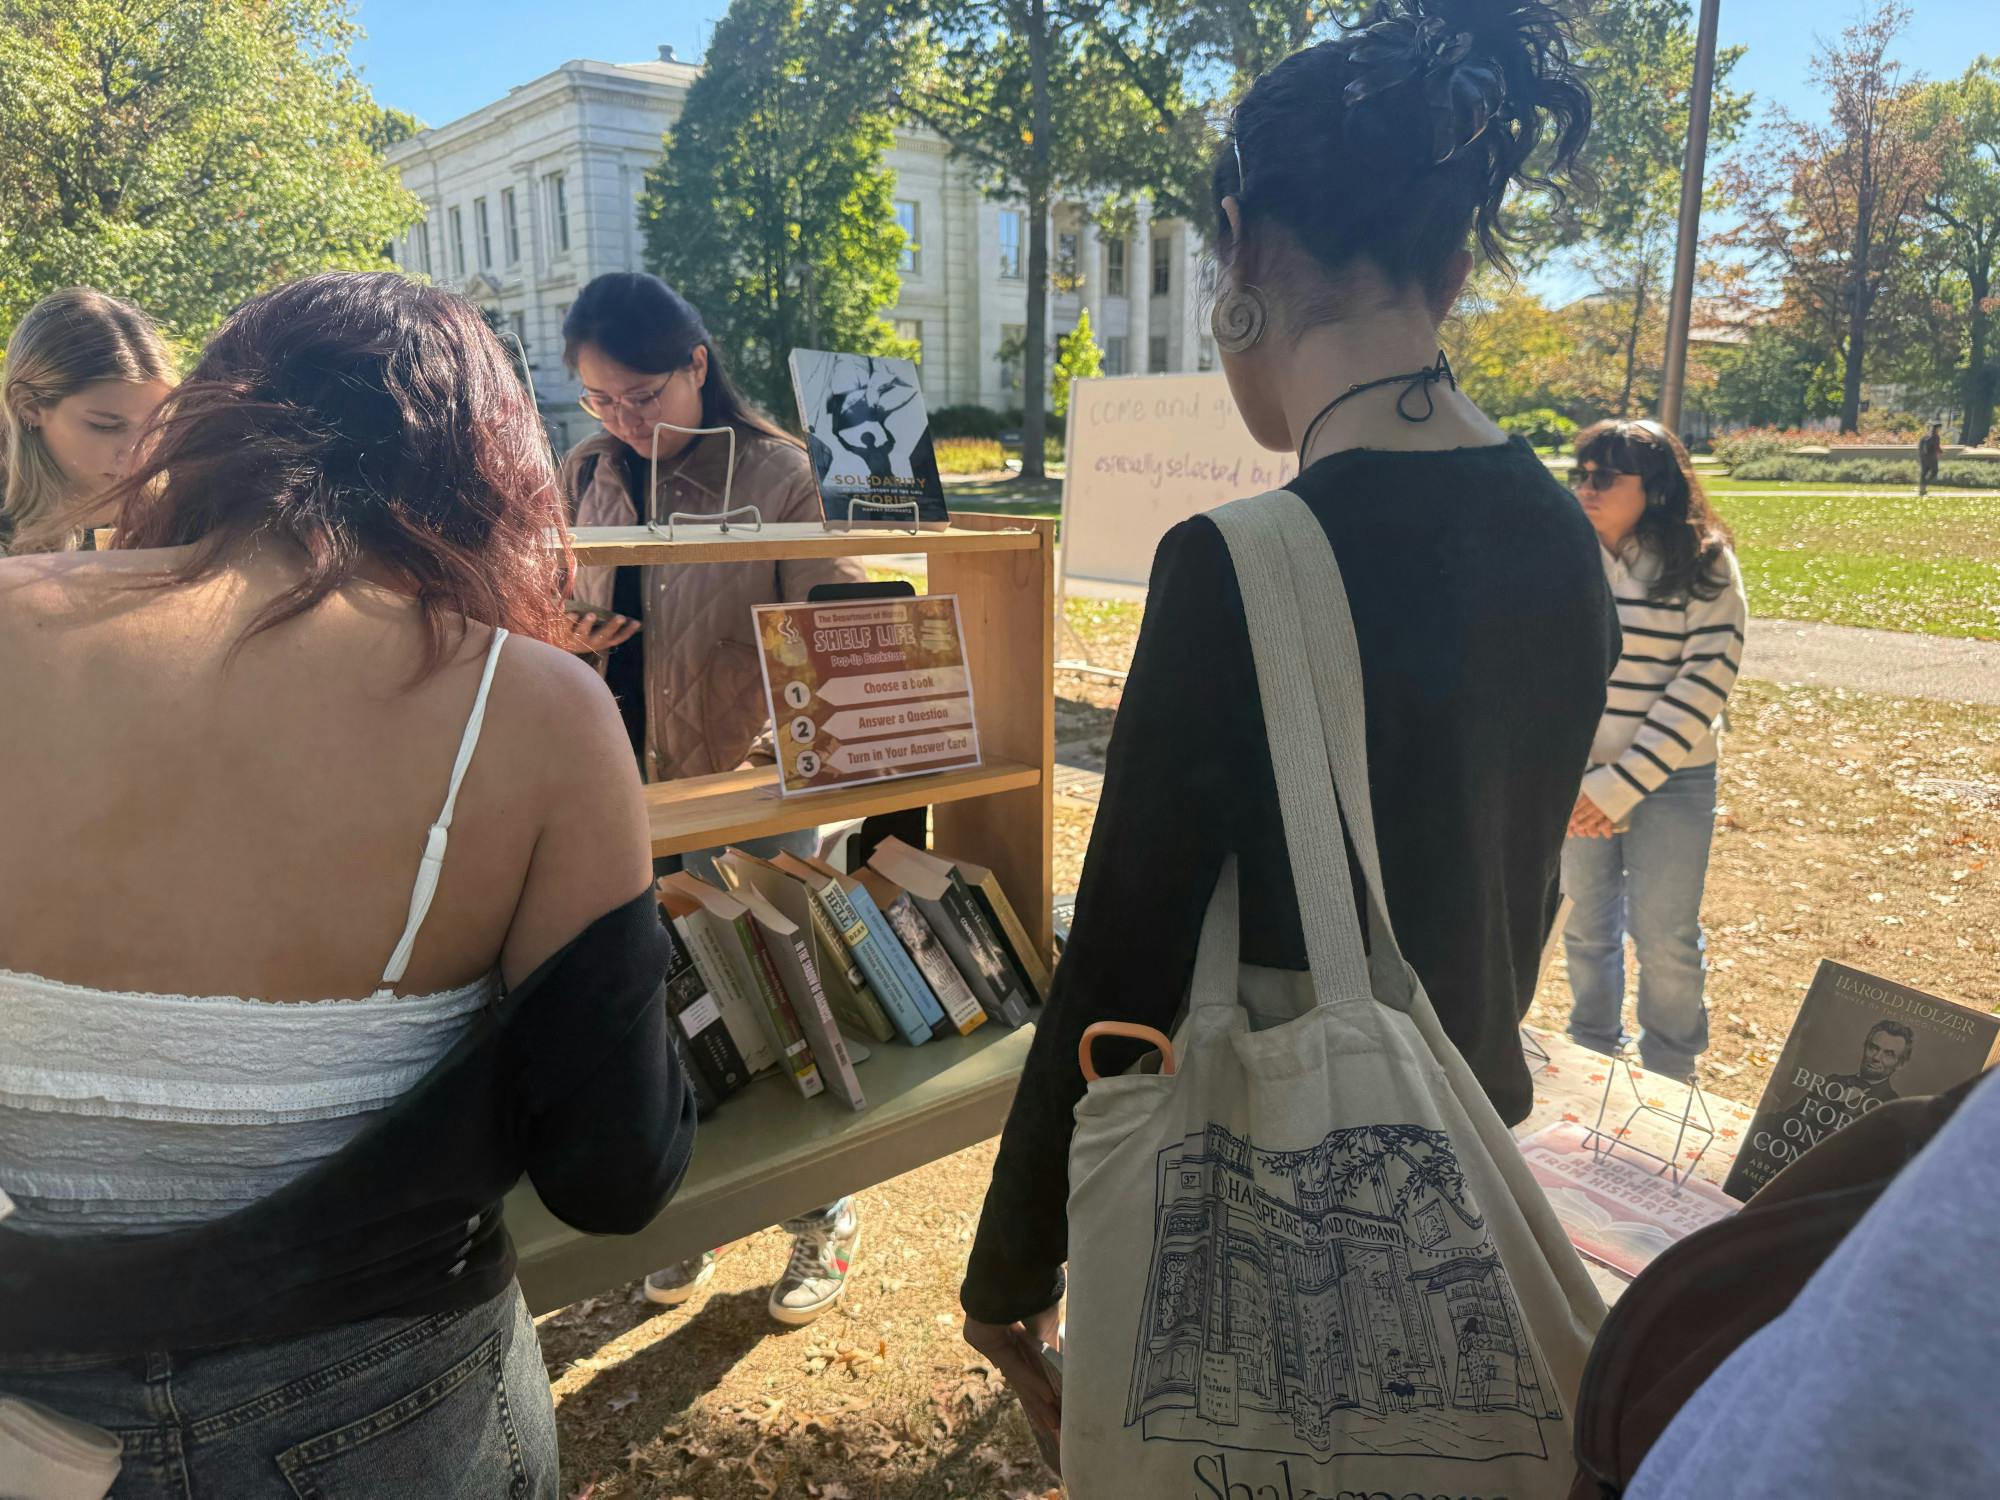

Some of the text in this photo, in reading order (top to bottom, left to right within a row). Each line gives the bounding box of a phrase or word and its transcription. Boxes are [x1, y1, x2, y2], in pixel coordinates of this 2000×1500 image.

[1155, 392, 1200, 419] and
[835, 474, 926, 489] SOLIDARITY
[1166, 451, 1242, 487] selected
[813, 623, 917, 652] SHELF LIFE
[792, 676, 935, 703] 1 Choose a book
[796, 708, 949, 738] 2 Answer a Question
[801, 736, 968, 773] 3 Turn in Your Answer Card
[825, 891, 849, 929] HELL
[1835, 975, 1977, 1035] HAROLD HOLZER
[1782, 1118, 1824, 1147] ON
[1535, 1152, 1587, 1178] FROM
[1589, 1177, 1672, 1215] HISTORY
[1183, 1174, 1197, 1186] 37
[1217, 1164, 1302, 1238] SHASPEARE
[1345, 1218, 1401, 1244] COMPANY
